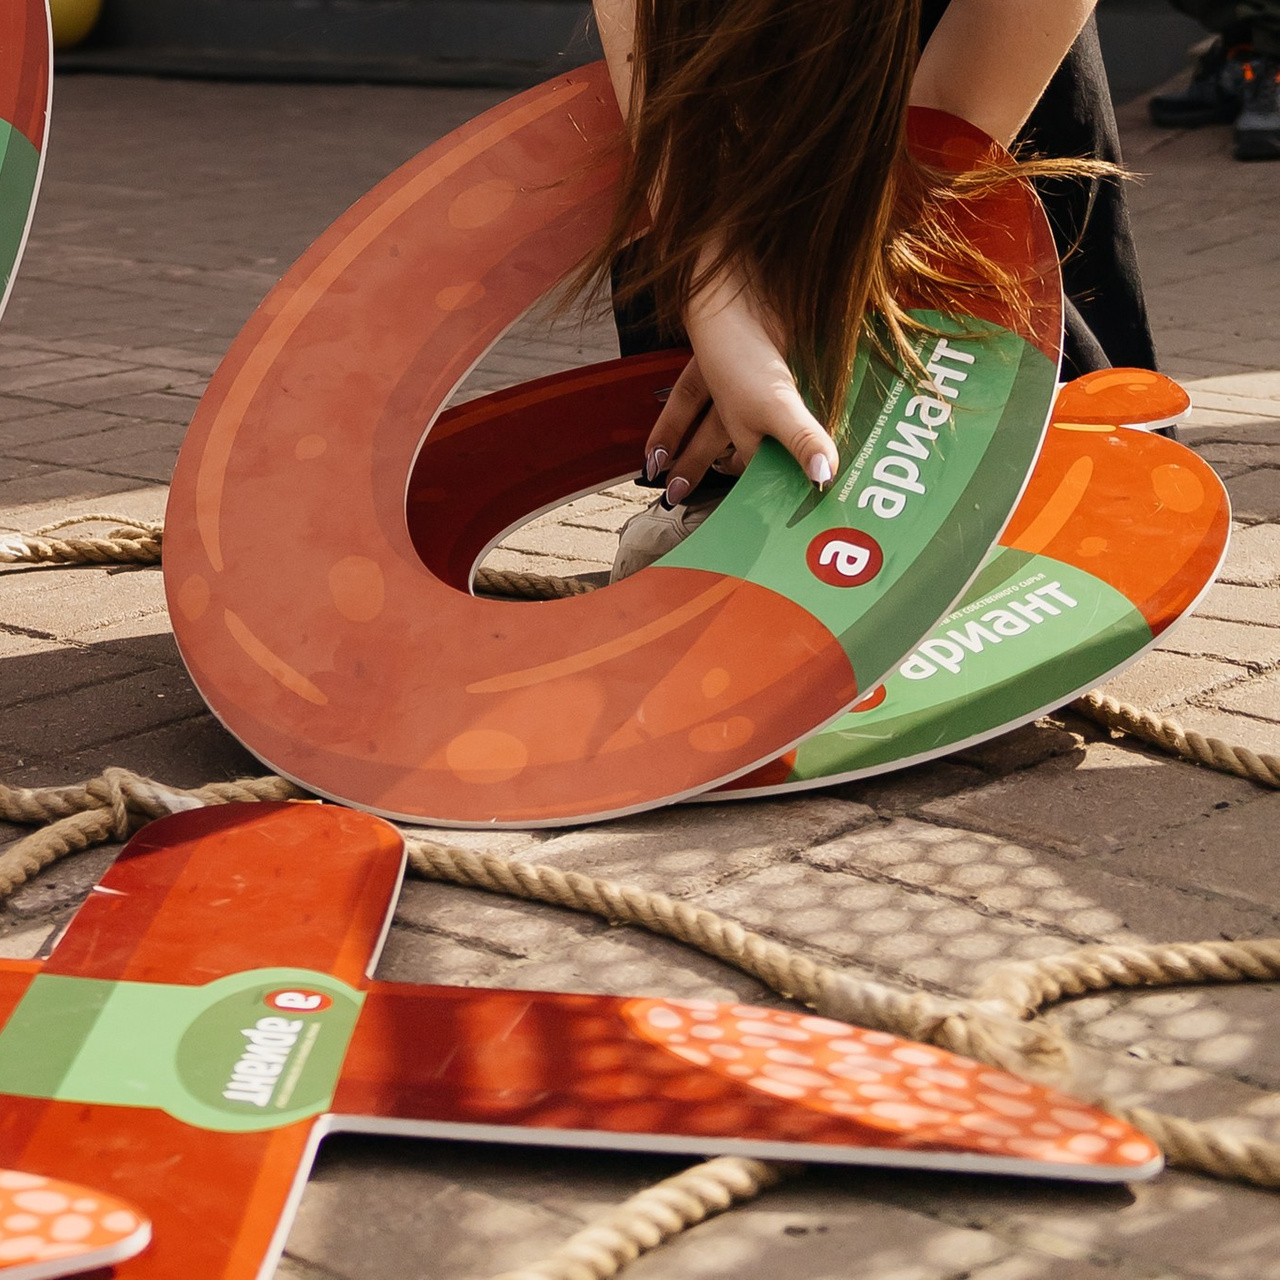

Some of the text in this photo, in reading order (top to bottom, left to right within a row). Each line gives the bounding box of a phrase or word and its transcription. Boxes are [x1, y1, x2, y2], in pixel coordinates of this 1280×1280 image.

[837, 469, 861, 502] МЯСНЫЕ
[856, 426, 882, 469] ПРОДУКТЫ
[876, 414, 889, 427] ИЗ
[857, 337, 975, 519] ариант
[221, 1015, 304, 1108] ариант
